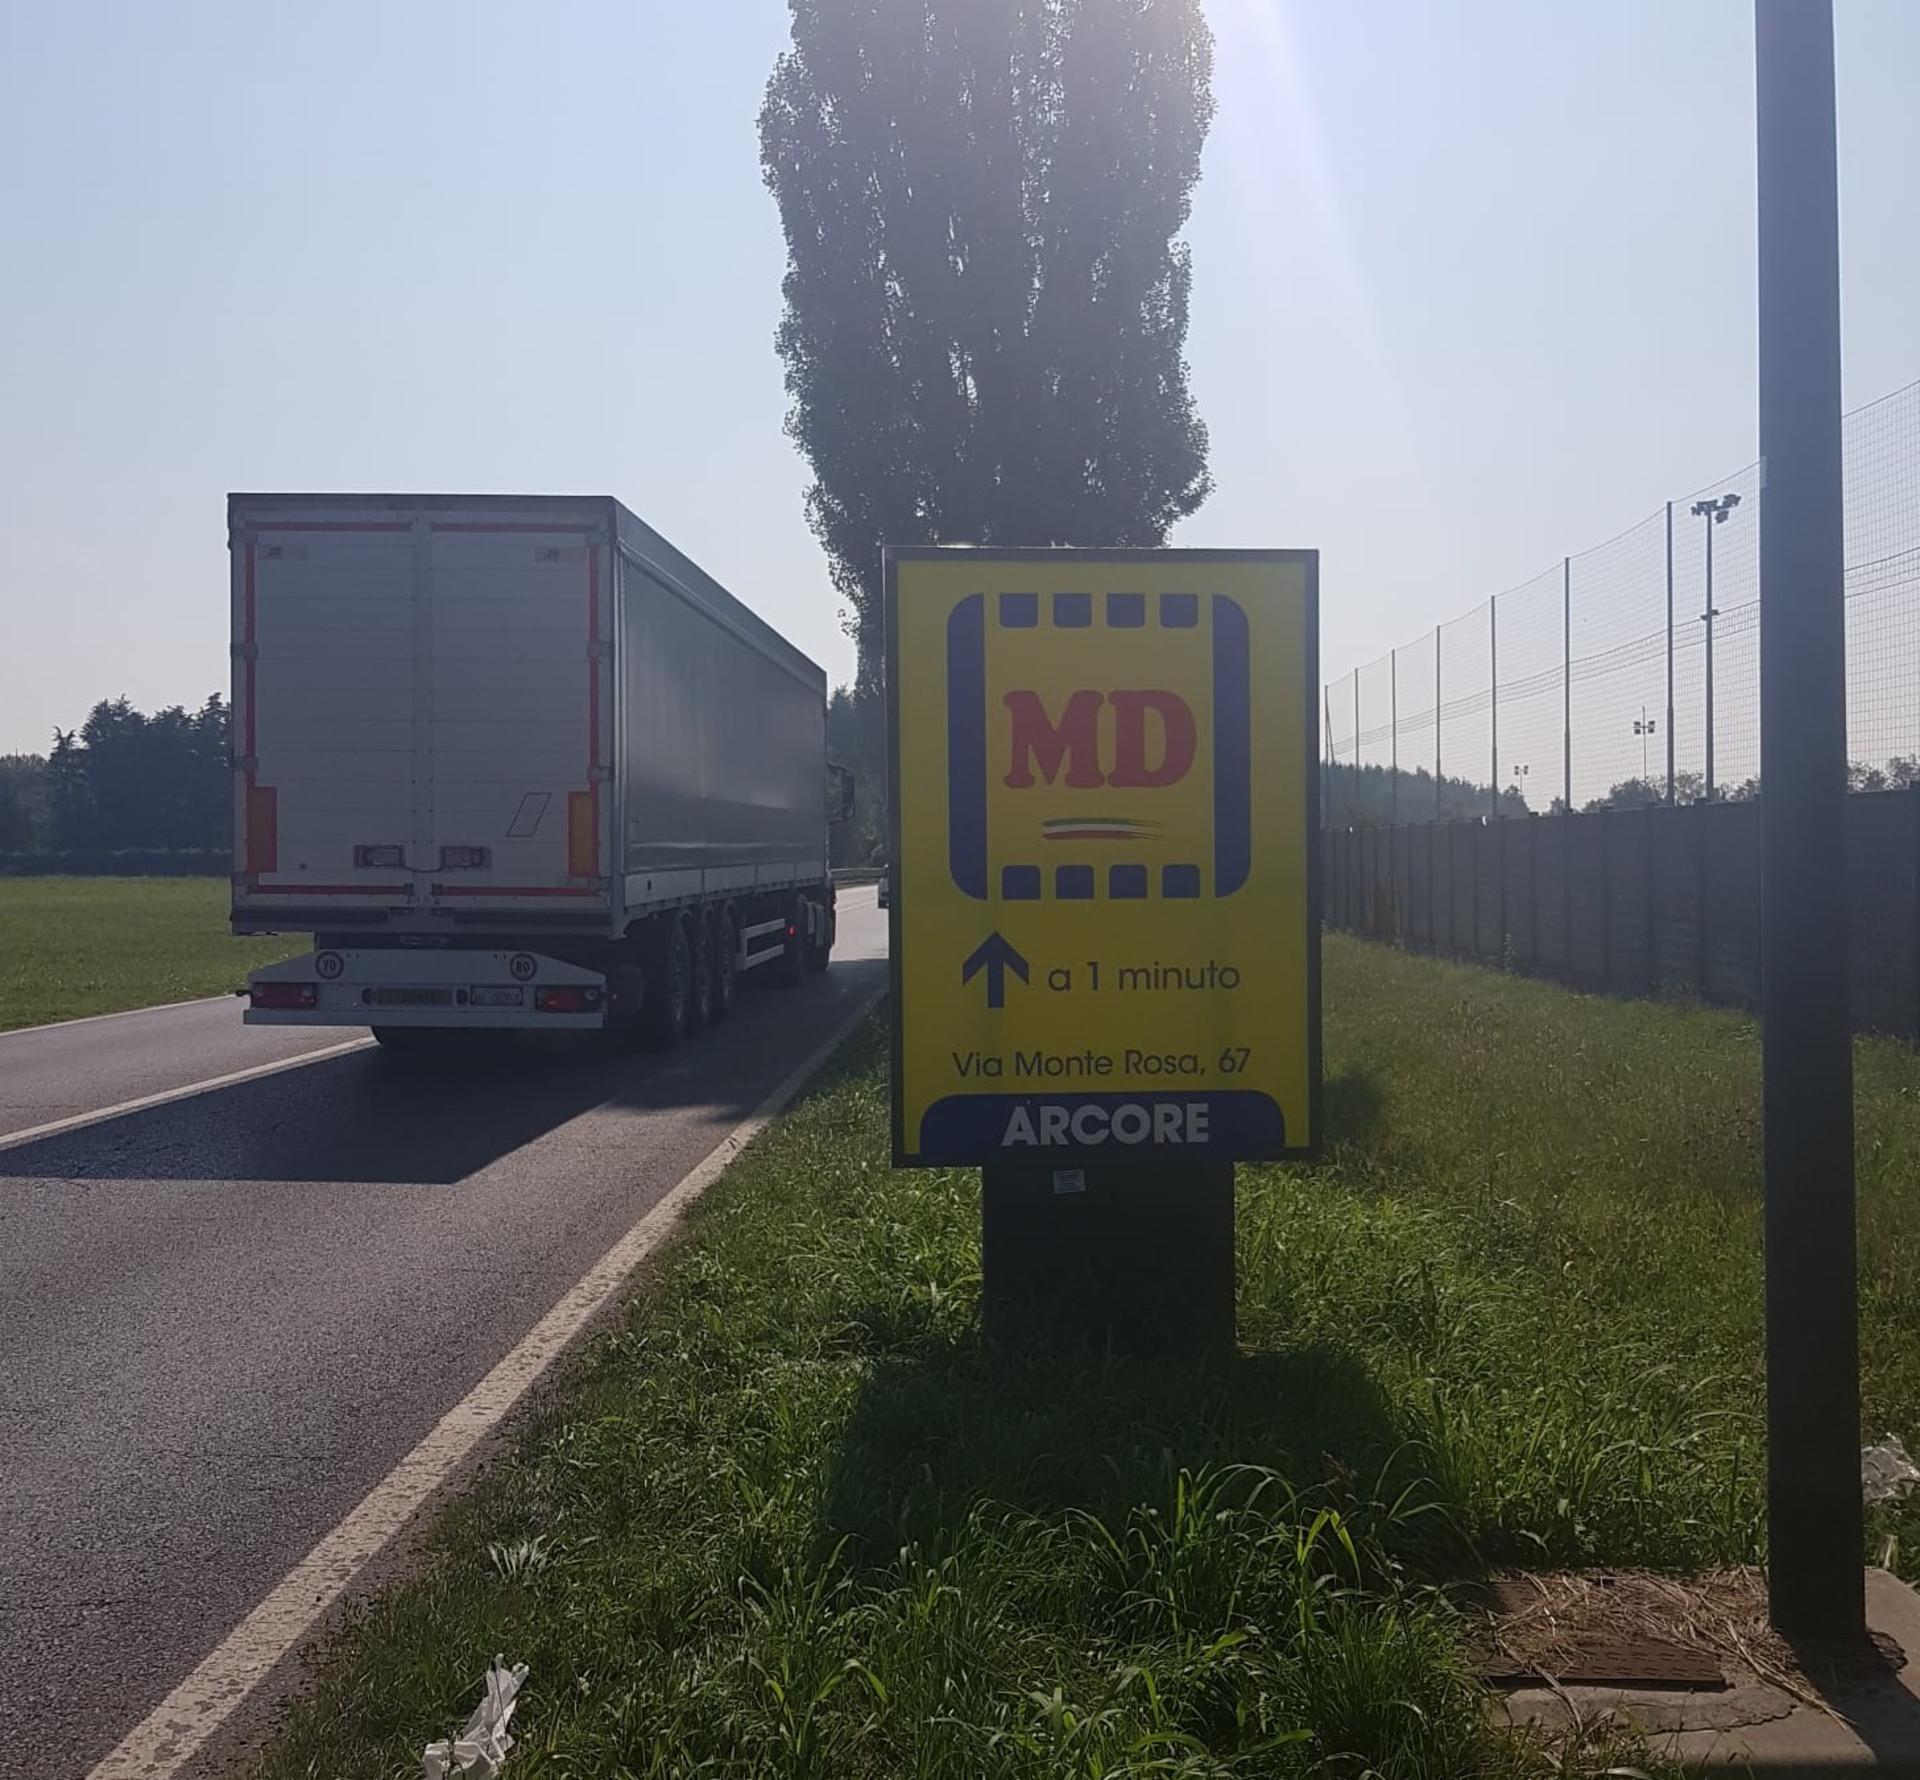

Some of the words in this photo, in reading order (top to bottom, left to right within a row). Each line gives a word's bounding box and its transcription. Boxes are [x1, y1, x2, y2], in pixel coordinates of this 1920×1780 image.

[1002, 689, 1198, 789] MD
[322, 959, 337, 972] 70
[515, 961, 531, 973] 80
[1048, 967, 1072, 991] a
[1086, 961, 1100, 990] 1
[1118, 960, 1241, 990] minuto
[952, 1051, 1002, 1077] Via
[1015, 1050, 1113, 1076] Monte
[1124, 1049, 1206, 1076] Rosa,
[1218, 1048, 1251, 1073] 67
[1001, 1102, 1210, 1146] ARCORE
